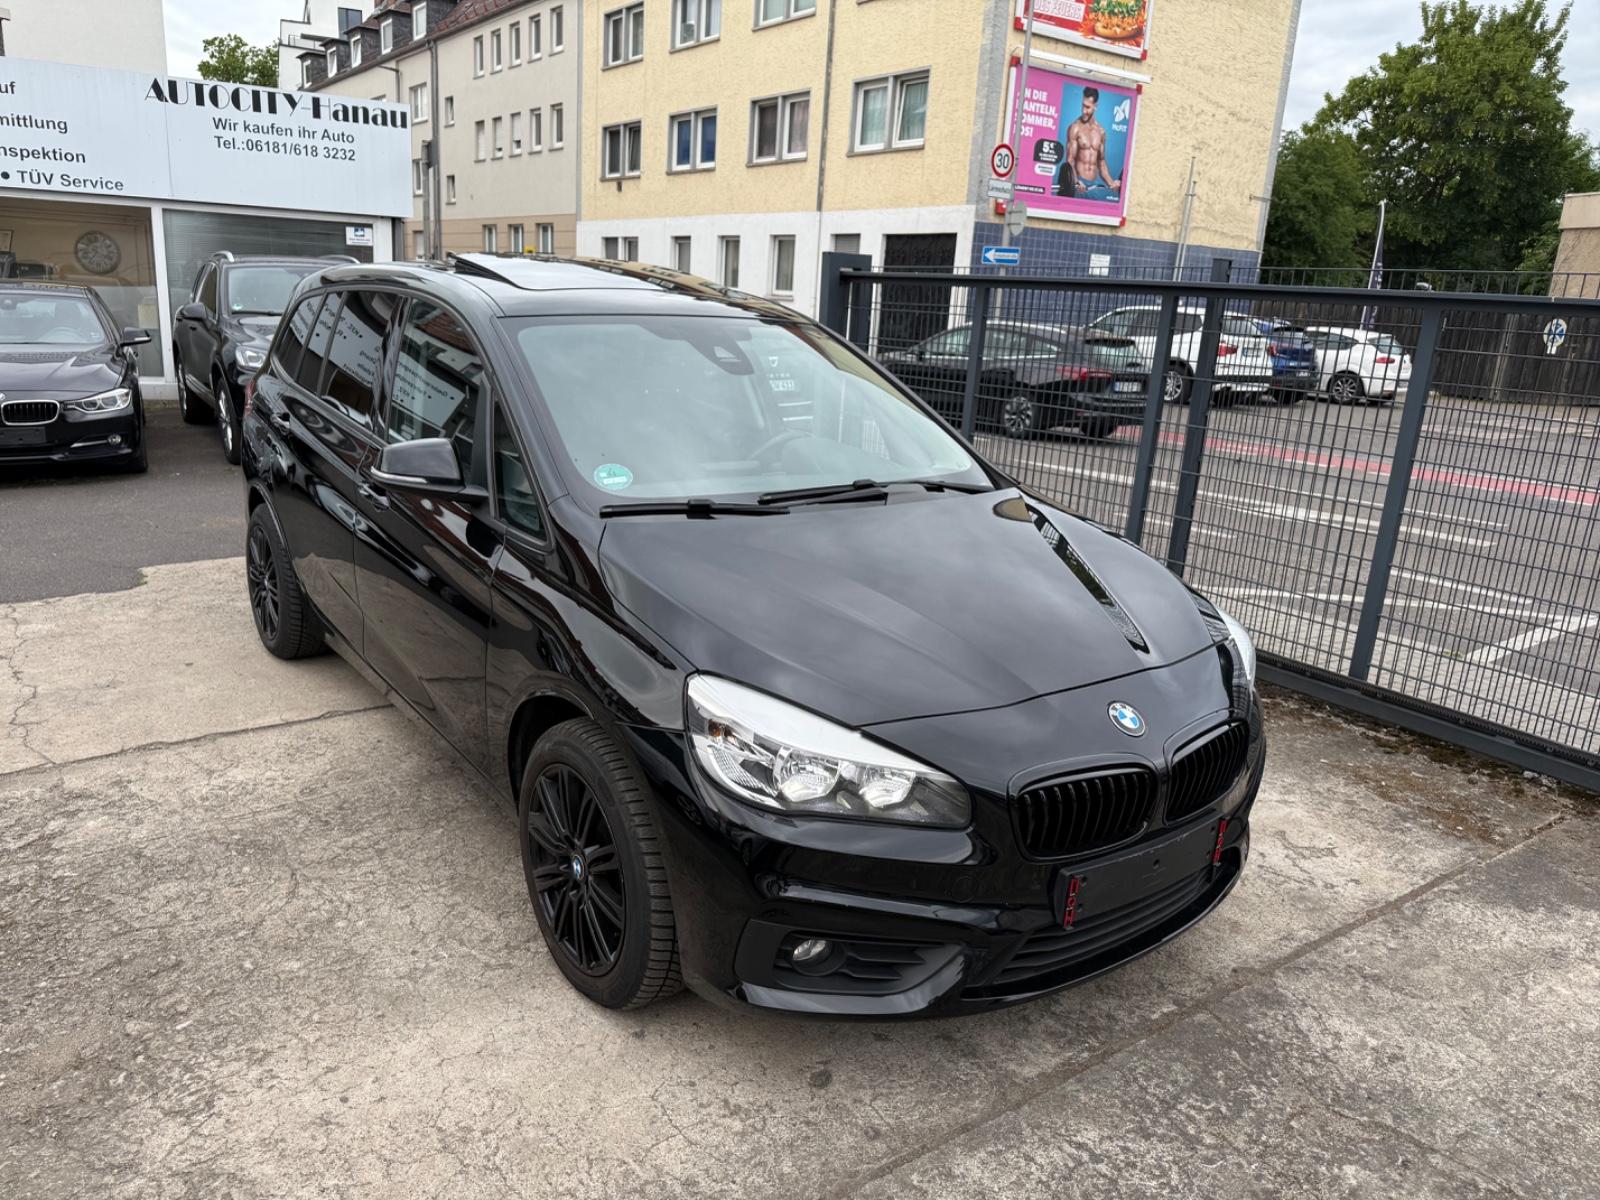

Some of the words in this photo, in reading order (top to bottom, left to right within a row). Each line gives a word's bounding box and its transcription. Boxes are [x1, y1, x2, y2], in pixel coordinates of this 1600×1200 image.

[145, 78, 408, 129] AUTOCITY-Hanau
[1032, 89, 1048, 102] DIE
[213, 117, 239, 132] Wir
[243, 120, 293, 138] kaufen
[298, 126, 317, 139] ihr
[321, 129, 355, 144] Auto
[214, 136, 318, 158] Tel.:06181/618
[323, 147, 356, 161] 3232
[996, 153, 1010, 169] 30
[17, 169, 54, 185] TÜV
[60, 174, 124, 191] Service
